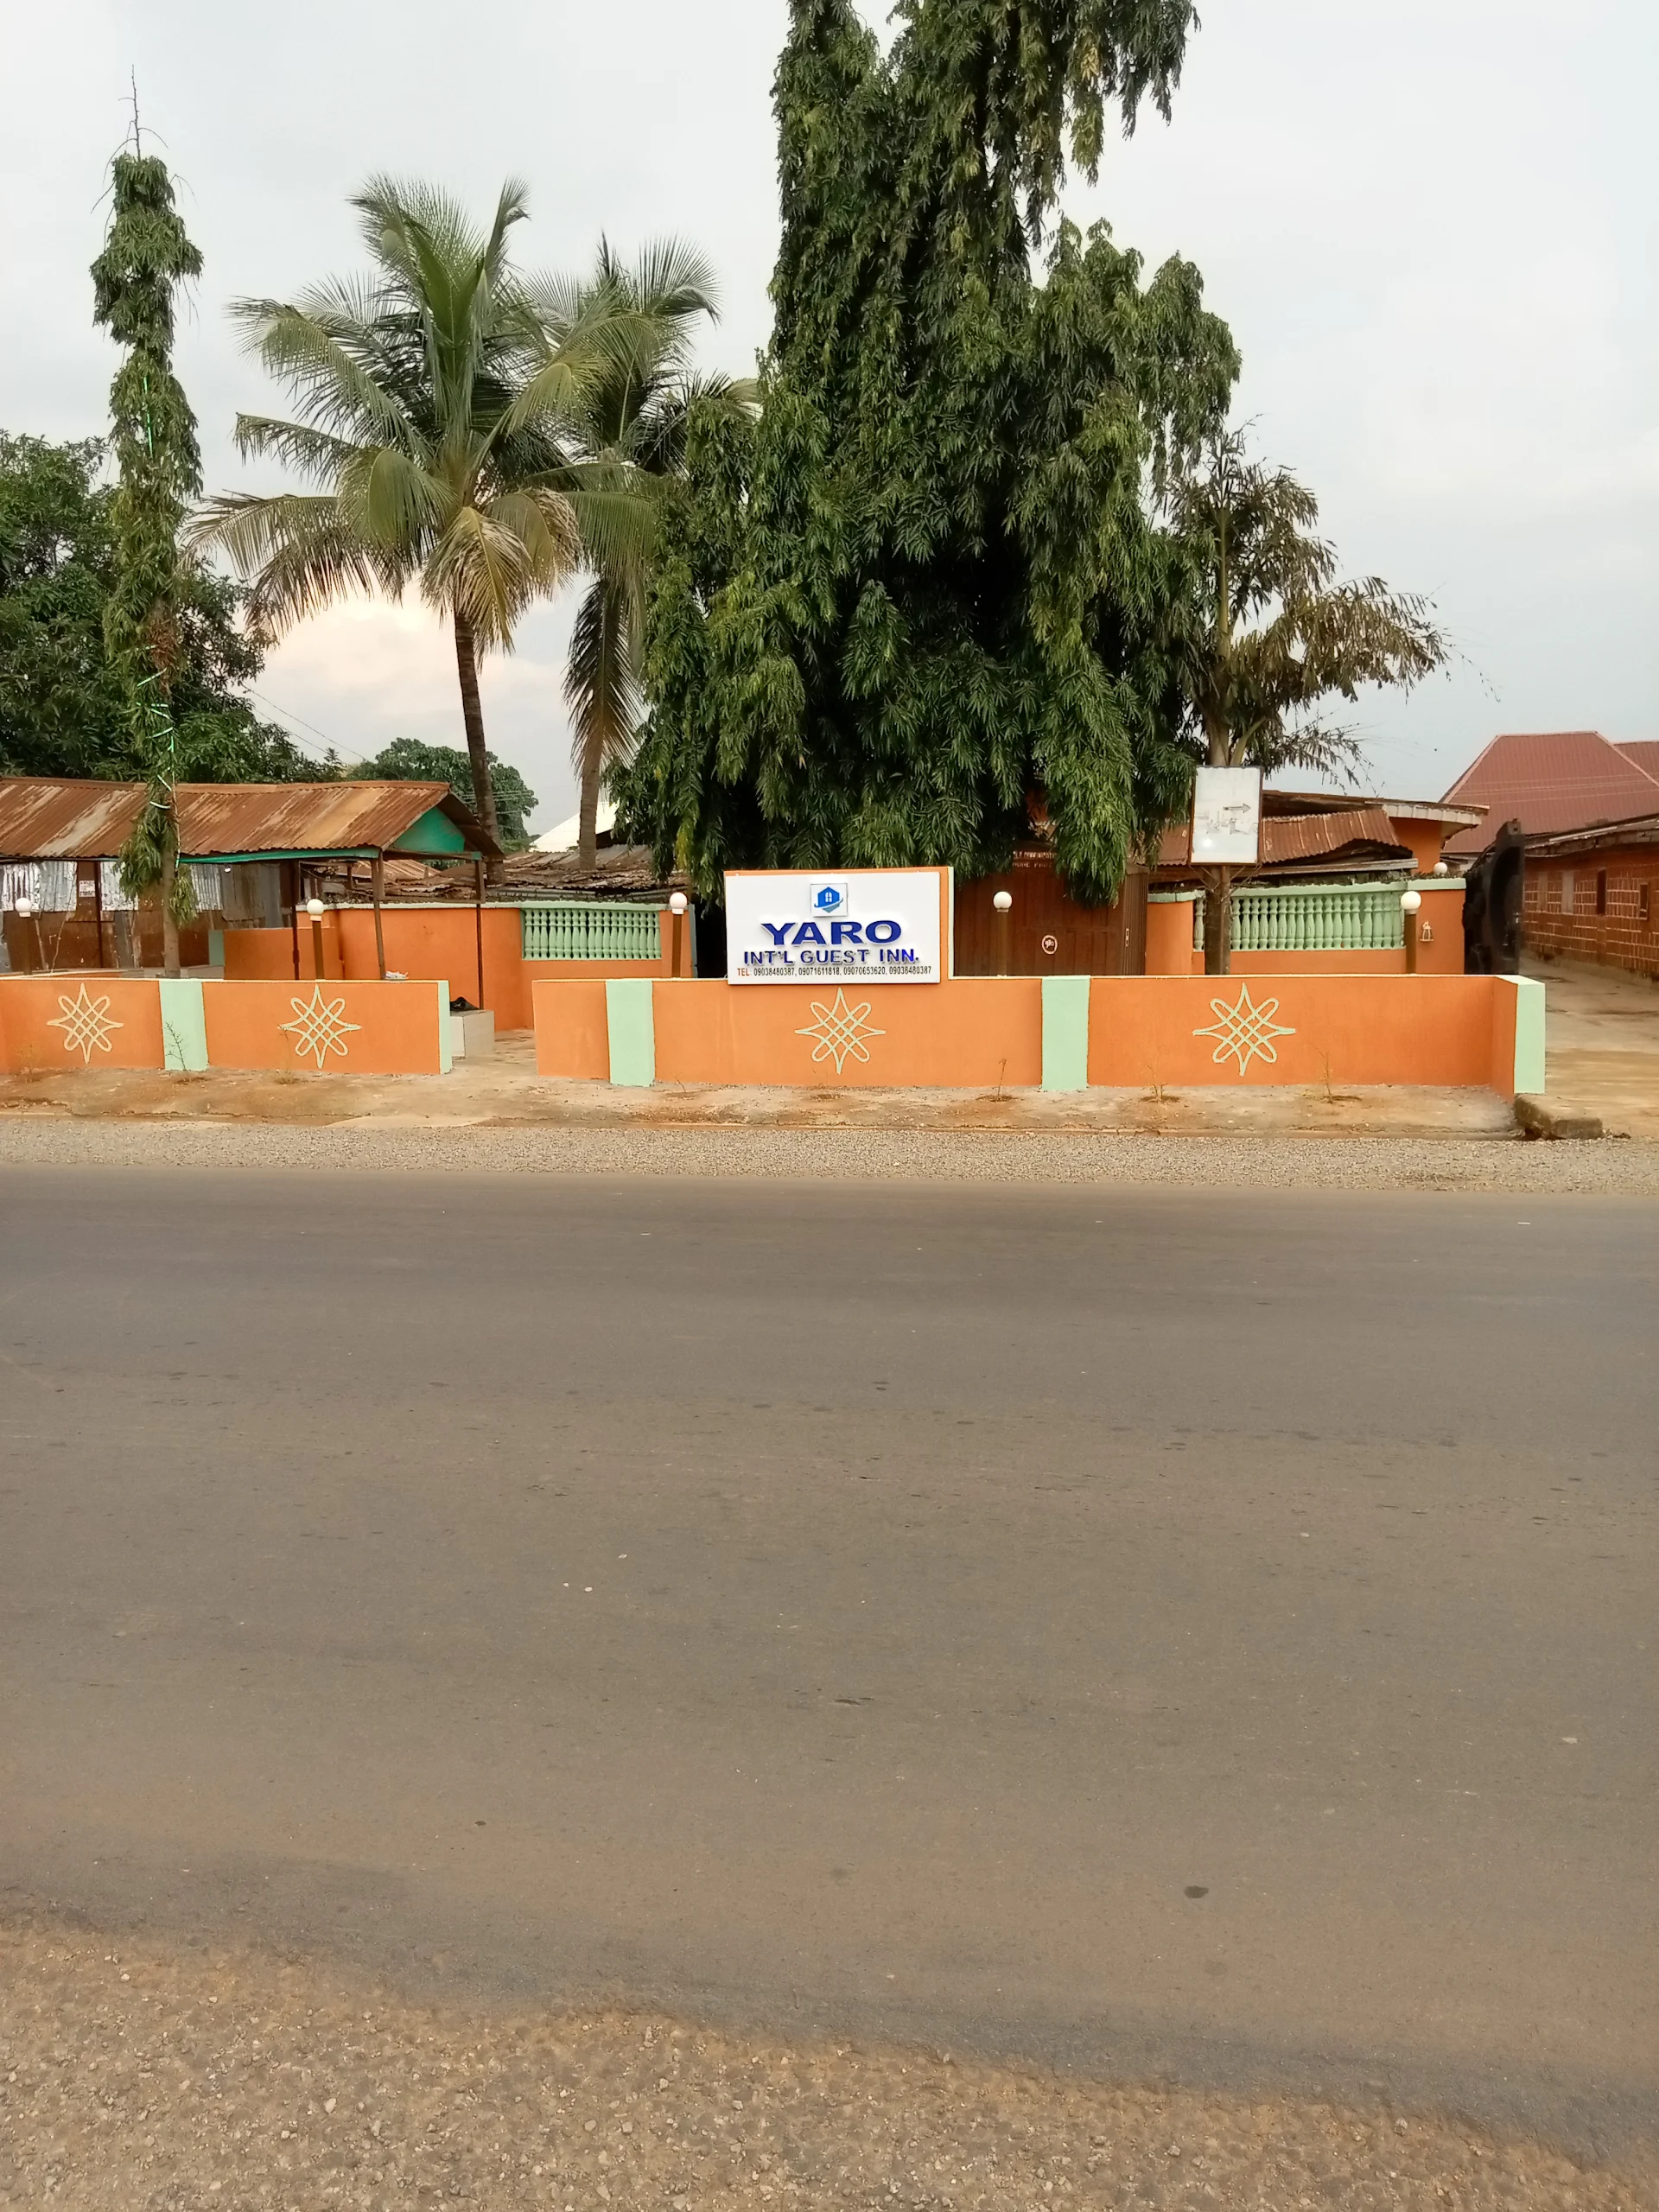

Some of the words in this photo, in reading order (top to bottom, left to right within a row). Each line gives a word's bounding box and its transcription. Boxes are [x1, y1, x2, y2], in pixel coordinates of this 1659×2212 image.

[760, 919, 902, 946] YARO
[744, 950, 793, 965] INT'L
[800, 950, 869, 964] GUEST
[880, 949, 919, 963] INN.
